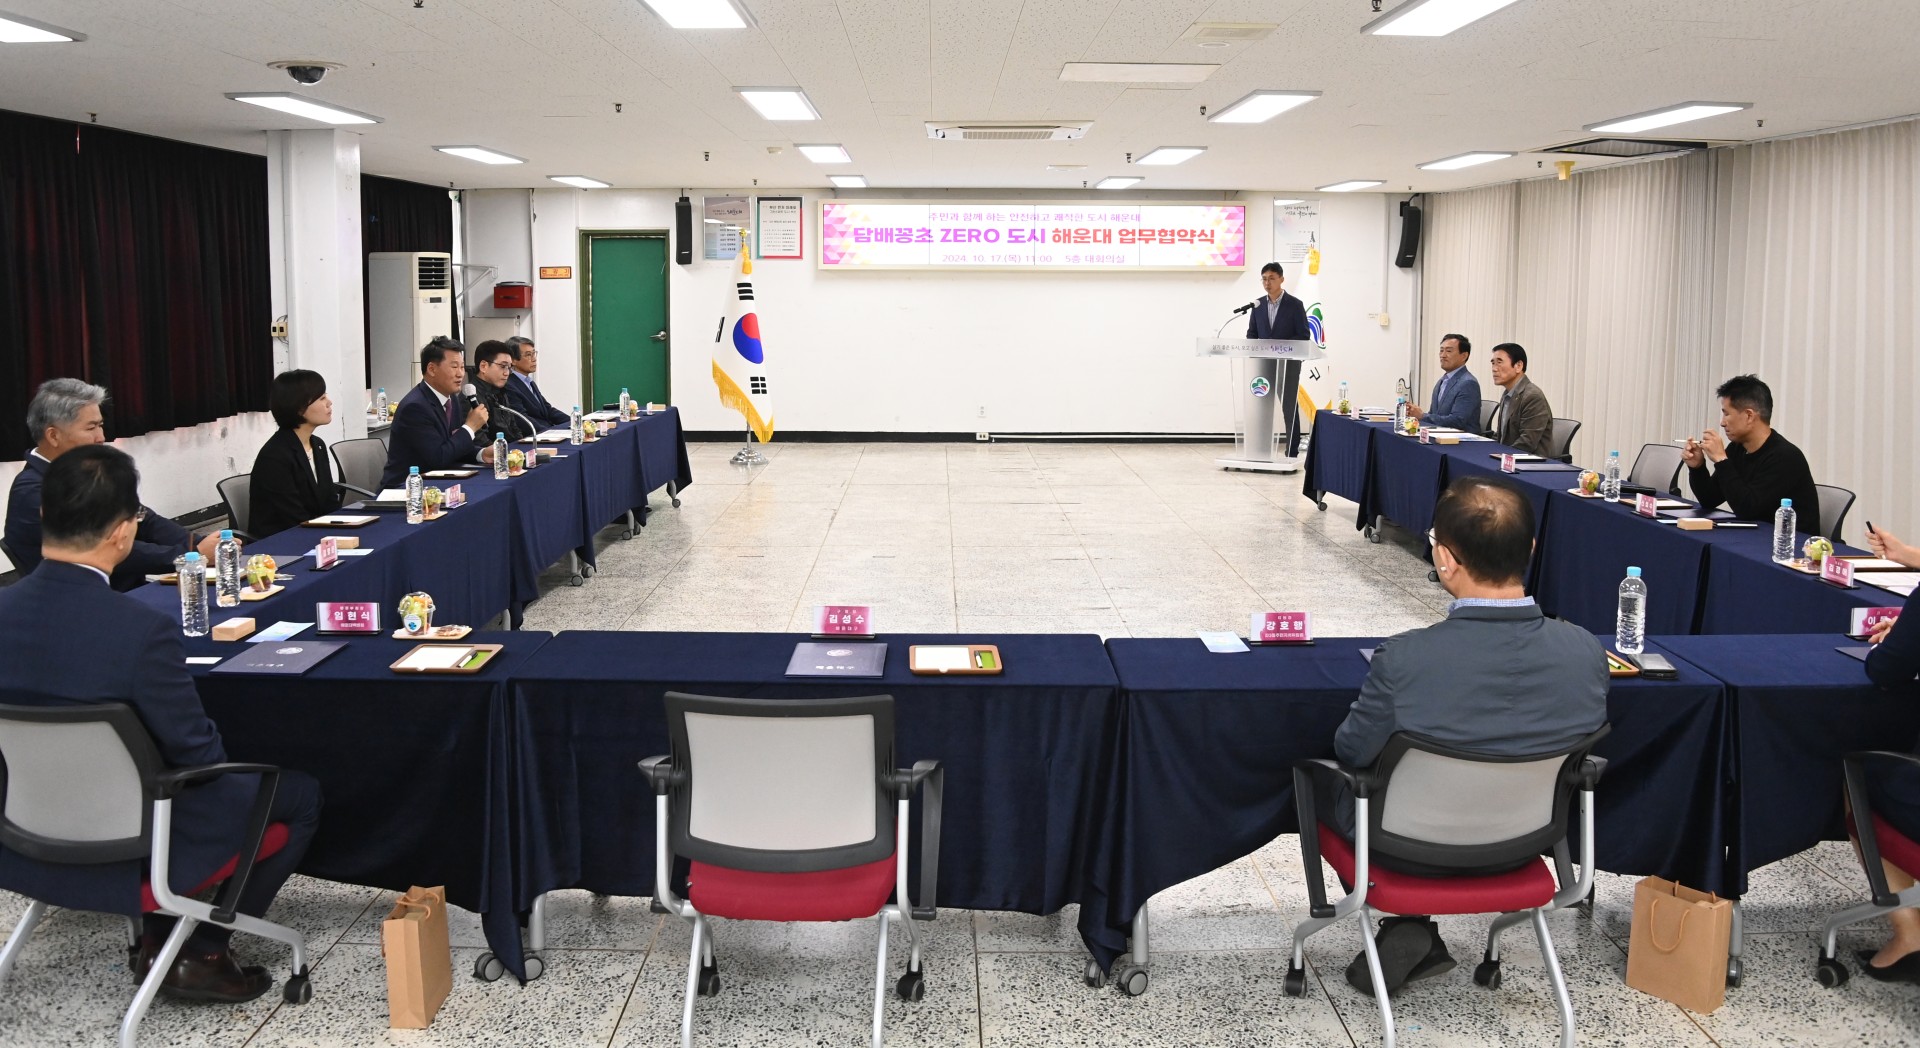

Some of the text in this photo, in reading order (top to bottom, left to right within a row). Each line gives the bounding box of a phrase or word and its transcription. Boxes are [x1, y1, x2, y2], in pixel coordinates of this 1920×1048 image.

[930, 212, 1141, 223] 주민과 함께 하는 안전하고 쾌적한 도시 해운대
[853, 227, 1215, 245] 담배꽁초 ZERO 도시 해운대 업무협약식
[942, 254, 1125, 264] 2024. 10. 17.(목) 11:00 5층 대회의실
[829, 614, 865, 624] 김성수
[1266, 620, 1303, 631] 강호행
